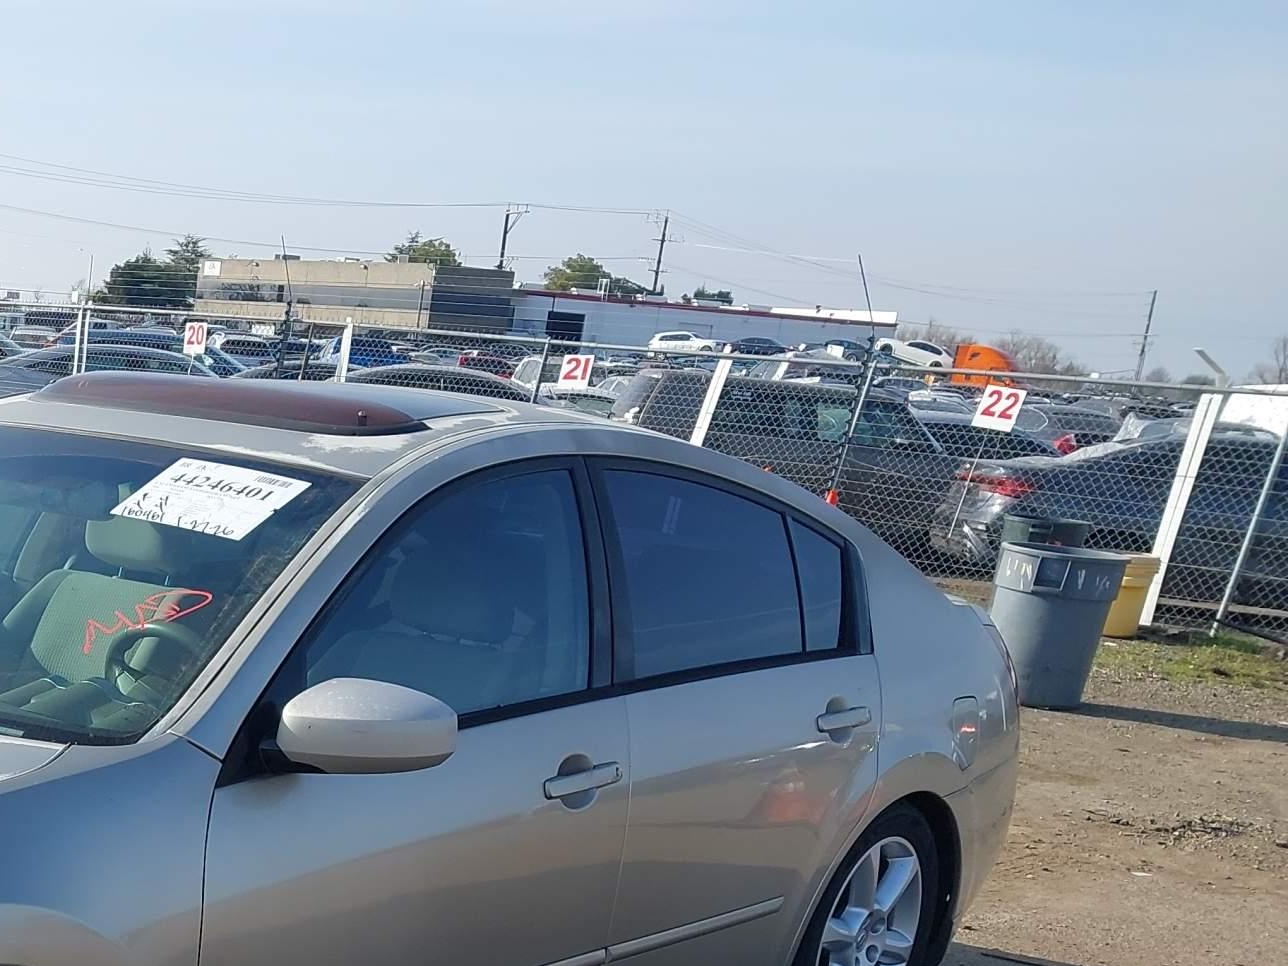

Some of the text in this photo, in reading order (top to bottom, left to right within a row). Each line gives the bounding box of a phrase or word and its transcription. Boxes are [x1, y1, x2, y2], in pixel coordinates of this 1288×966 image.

[186, 324, 205, 346] 20
[562, 357, 592, 380] 21
[980, 389, 1020, 420] 22
[170, 473, 274, 501] 44246401
